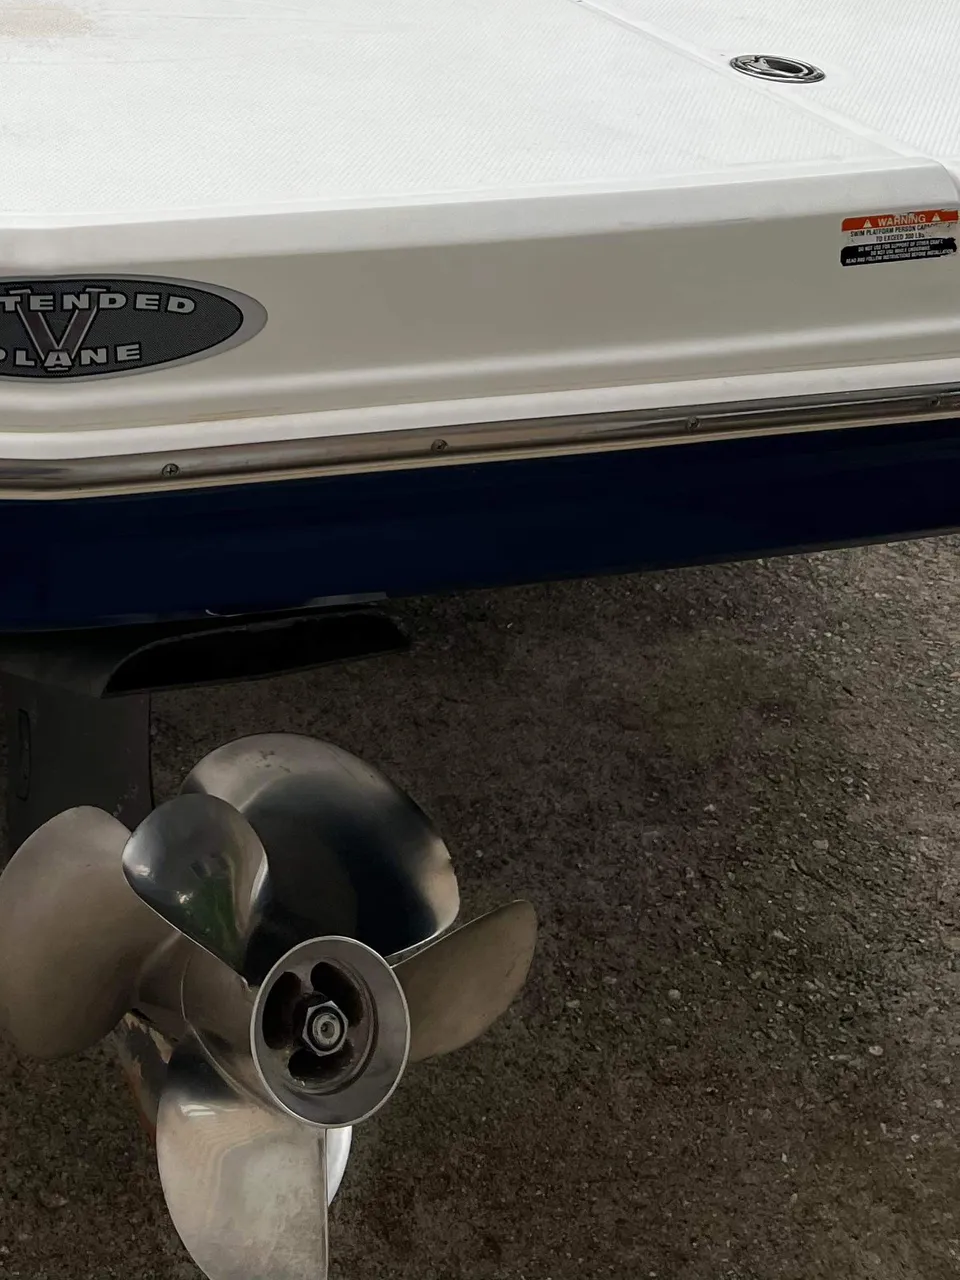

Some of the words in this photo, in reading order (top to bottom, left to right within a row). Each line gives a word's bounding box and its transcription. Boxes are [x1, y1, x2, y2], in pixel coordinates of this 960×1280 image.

[877, 214, 926, 227] WARNING
[866, 227, 894, 236] PLATFORM
[895, 225, 916, 233] PERSON
[884, 234, 904, 242] EXCEED
